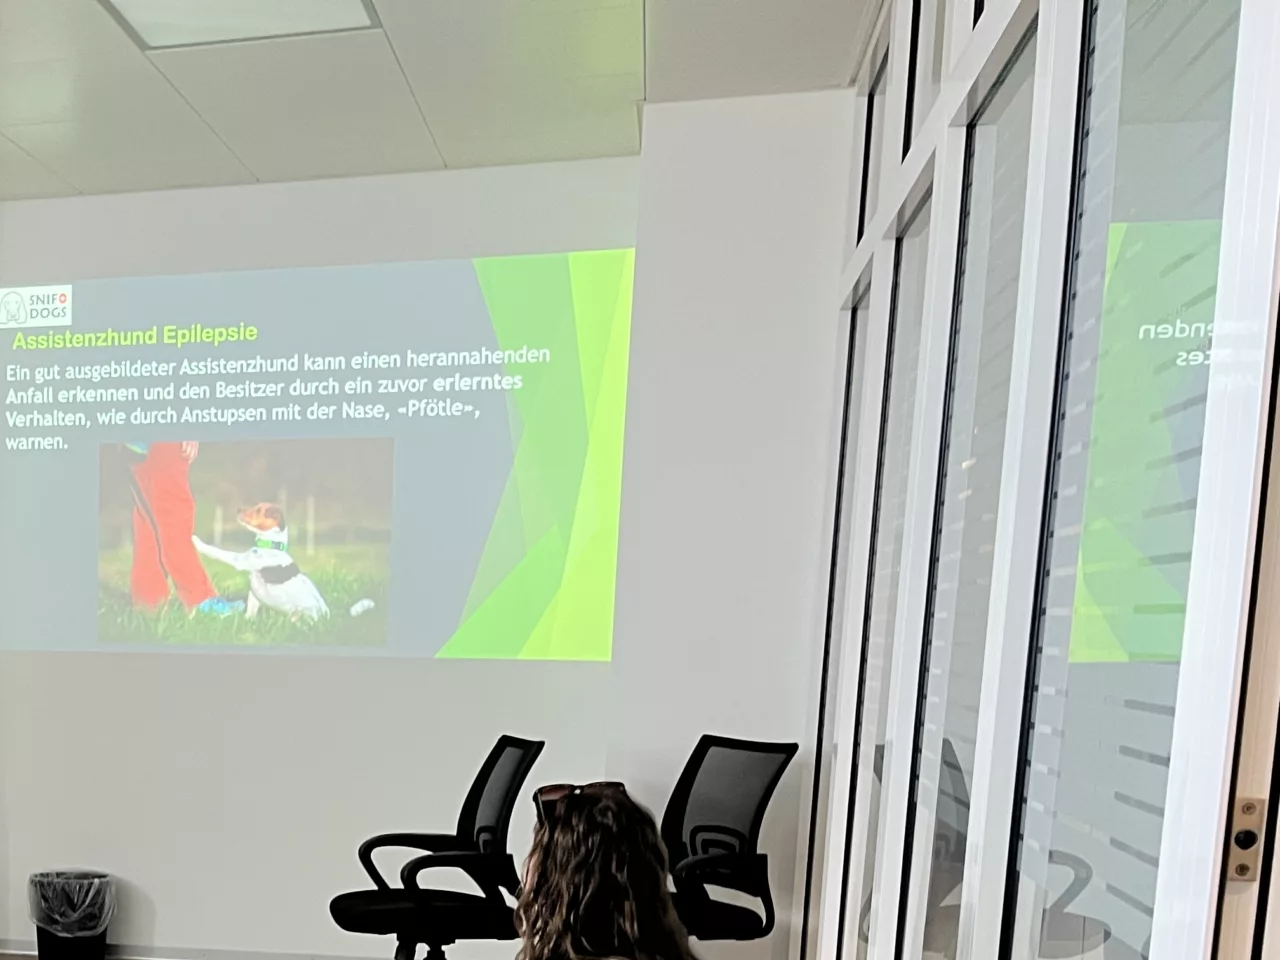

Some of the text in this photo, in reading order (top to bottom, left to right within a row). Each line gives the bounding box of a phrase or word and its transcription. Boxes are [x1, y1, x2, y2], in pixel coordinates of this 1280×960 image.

[29, 292, 68, 306] SNIFO
[30, 307, 67, 319] DOGS
[12, 322, 258, 349] Assistenzhund Epilepsie
[6, 345, 550, 383] Ein gut ausgebildeter Assistenzhund kann einen herannahenden
[5, 373, 523, 404] Anfall erkennen und den Besitzer durch ein zuvor erlerntes
[5, 410, 91, 428] Verhalten,
[97, 408, 126, 425] wie
[130, 406, 177, 424] durch
[180, 406, 266, 426] Anstupsen
[272, 403, 301, 421] mit
[307, 402, 336, 419] der
[342, 401, 390, 420] Nase,
[5, 436, 69, 450] warnen.
